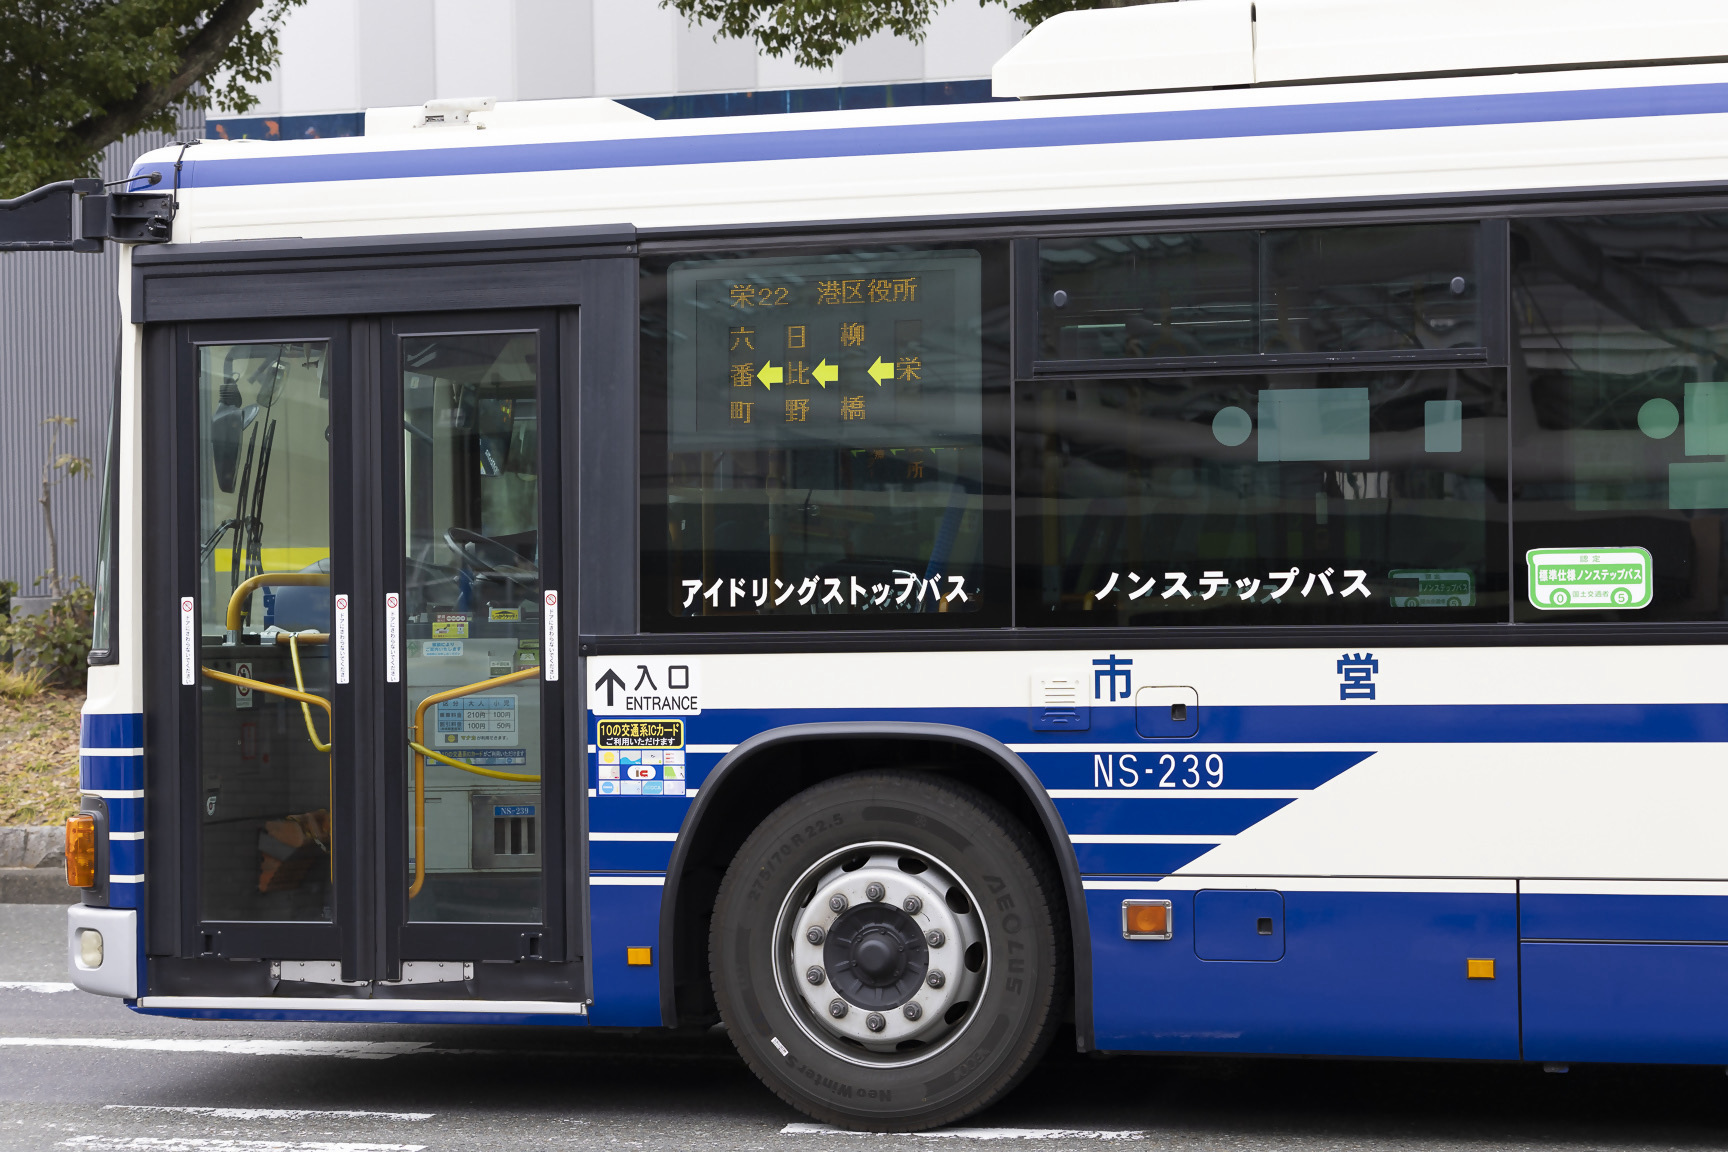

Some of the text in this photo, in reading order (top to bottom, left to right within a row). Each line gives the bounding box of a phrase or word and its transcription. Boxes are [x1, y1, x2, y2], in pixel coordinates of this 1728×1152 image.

[817, 277, 918, 305] 港区役所
[730, 326, 755, 424] 六番町
[785, 325, 811, 423] 日比野
[896, 356, 922, 382] 栄
[1095, 566, 1372, 601] ノンステップバス
[1538, 568, 1642, 582] 標準仕様ノンステップバス
[681, 574, 969, 609] アイドリングストップバス
[1617, 592, 1625, 603] 5
[634, 664, 690, 691] 入口
[467, 711, 486, 719] 210円
[626, 696, 698, 711] ENTRANCE
[467, 722, 486, 730] 100円
[600, 723, 680, 738] 10の交通系ICカード
[605, 737, 676, 747] ご利用いただけます
[1093, 753, 1225, 789] NS-239
[500, 807, 529, 815] NS-239
[981, 875, 1025, 996] AEOLUS
